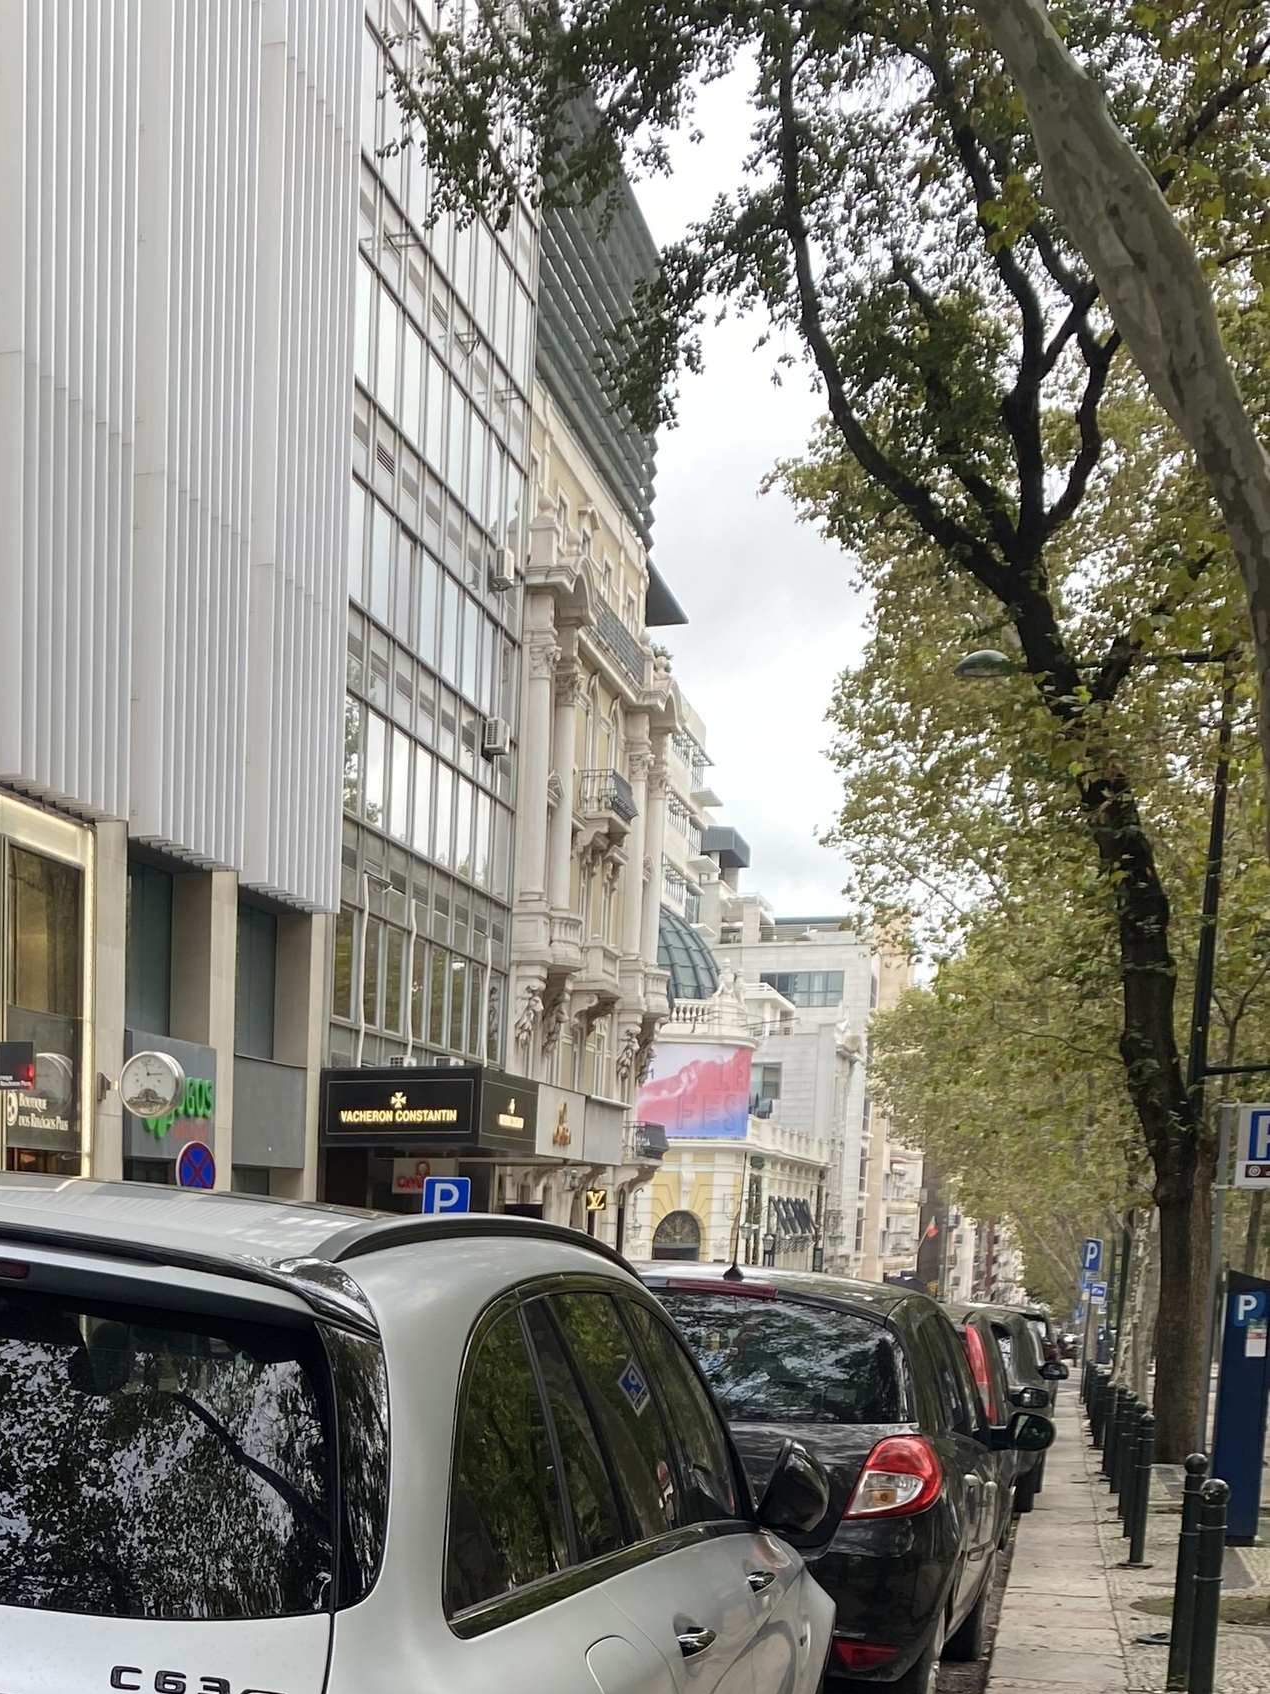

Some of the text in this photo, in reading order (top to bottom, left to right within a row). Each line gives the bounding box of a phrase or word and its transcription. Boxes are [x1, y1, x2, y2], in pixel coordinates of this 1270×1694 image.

[340, 1109, 458, 1123] VACHERON CONSTANTIN
[433, 1183, 460, 1214] P
[1085, 1242, 1099, 1268] P
[1238, 1294, 1258, 1320] P
